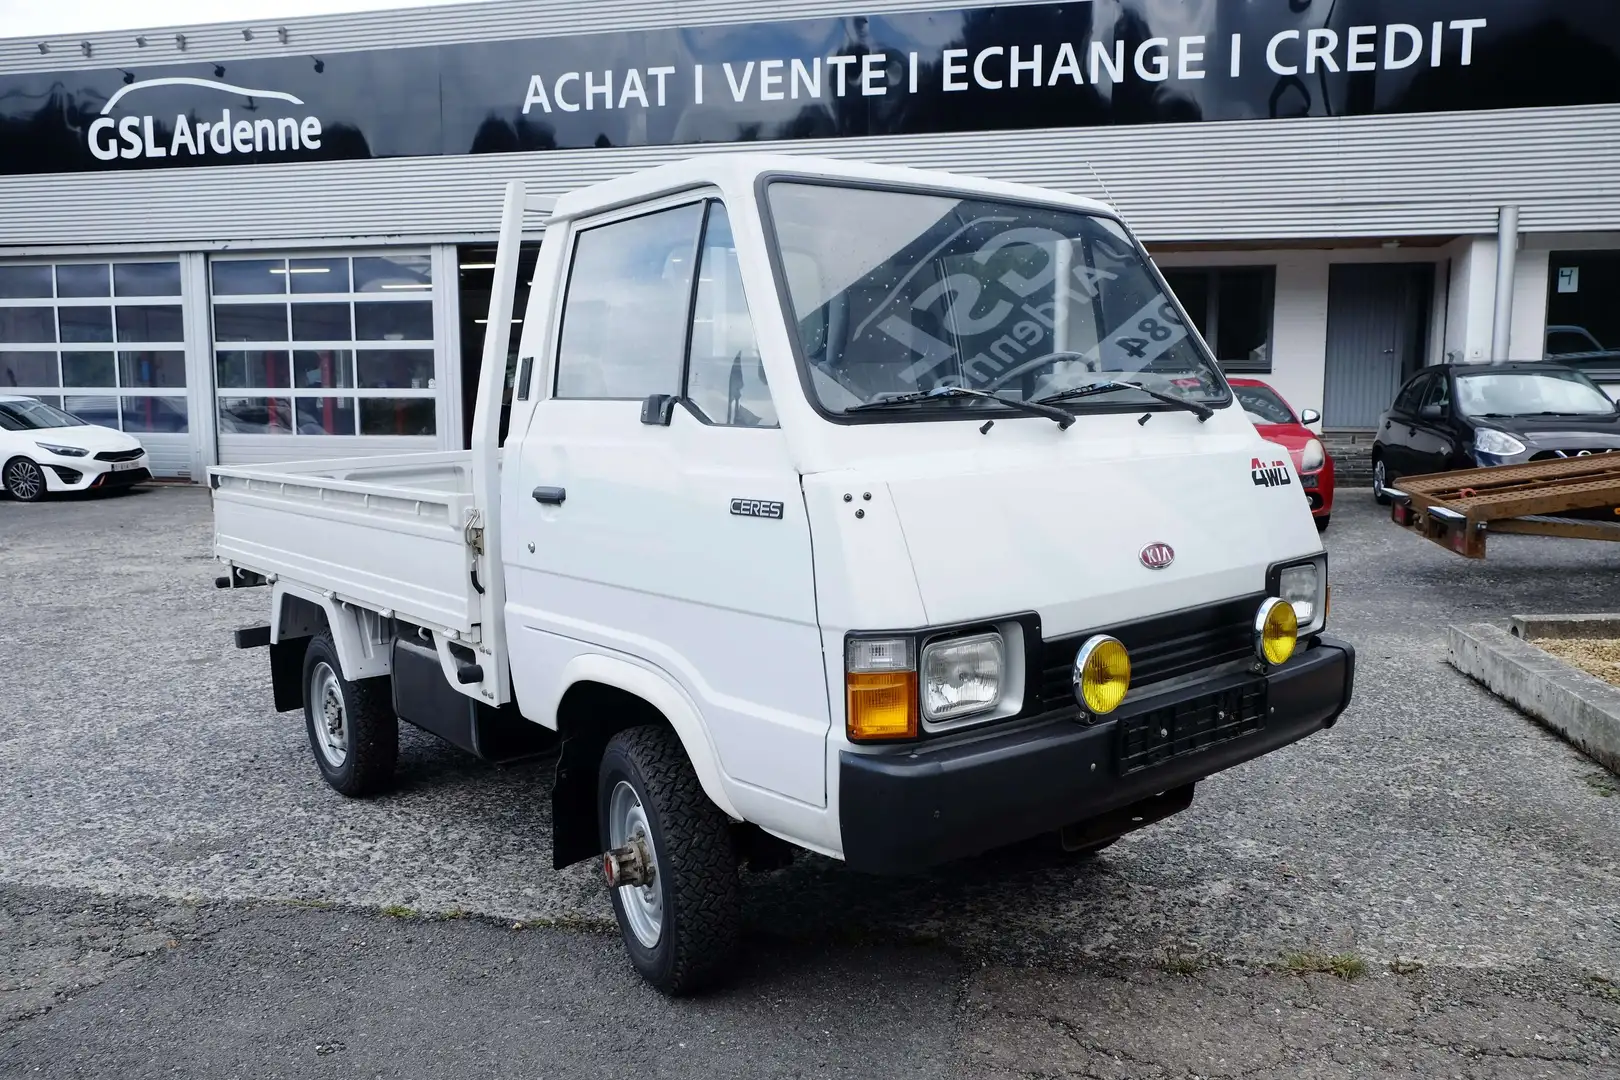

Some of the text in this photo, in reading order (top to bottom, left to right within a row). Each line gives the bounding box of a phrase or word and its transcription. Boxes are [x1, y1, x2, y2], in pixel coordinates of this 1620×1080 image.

[521, 65, 676, 115] ACHAT
[722, 53, 887, 102] VENTE
[942, 35, 1206, 92] ECHANGE
[1265, 18, 1487, 76] CREDIT
[87, 108, 322, 161] GSL Ardenne
[1560, 269, 1573, 286] 4
[1251, 457, 1292, 488] 4WD
[730, 499, 782, 518] CERES
[1145, 546, 1172, 564] KIA
